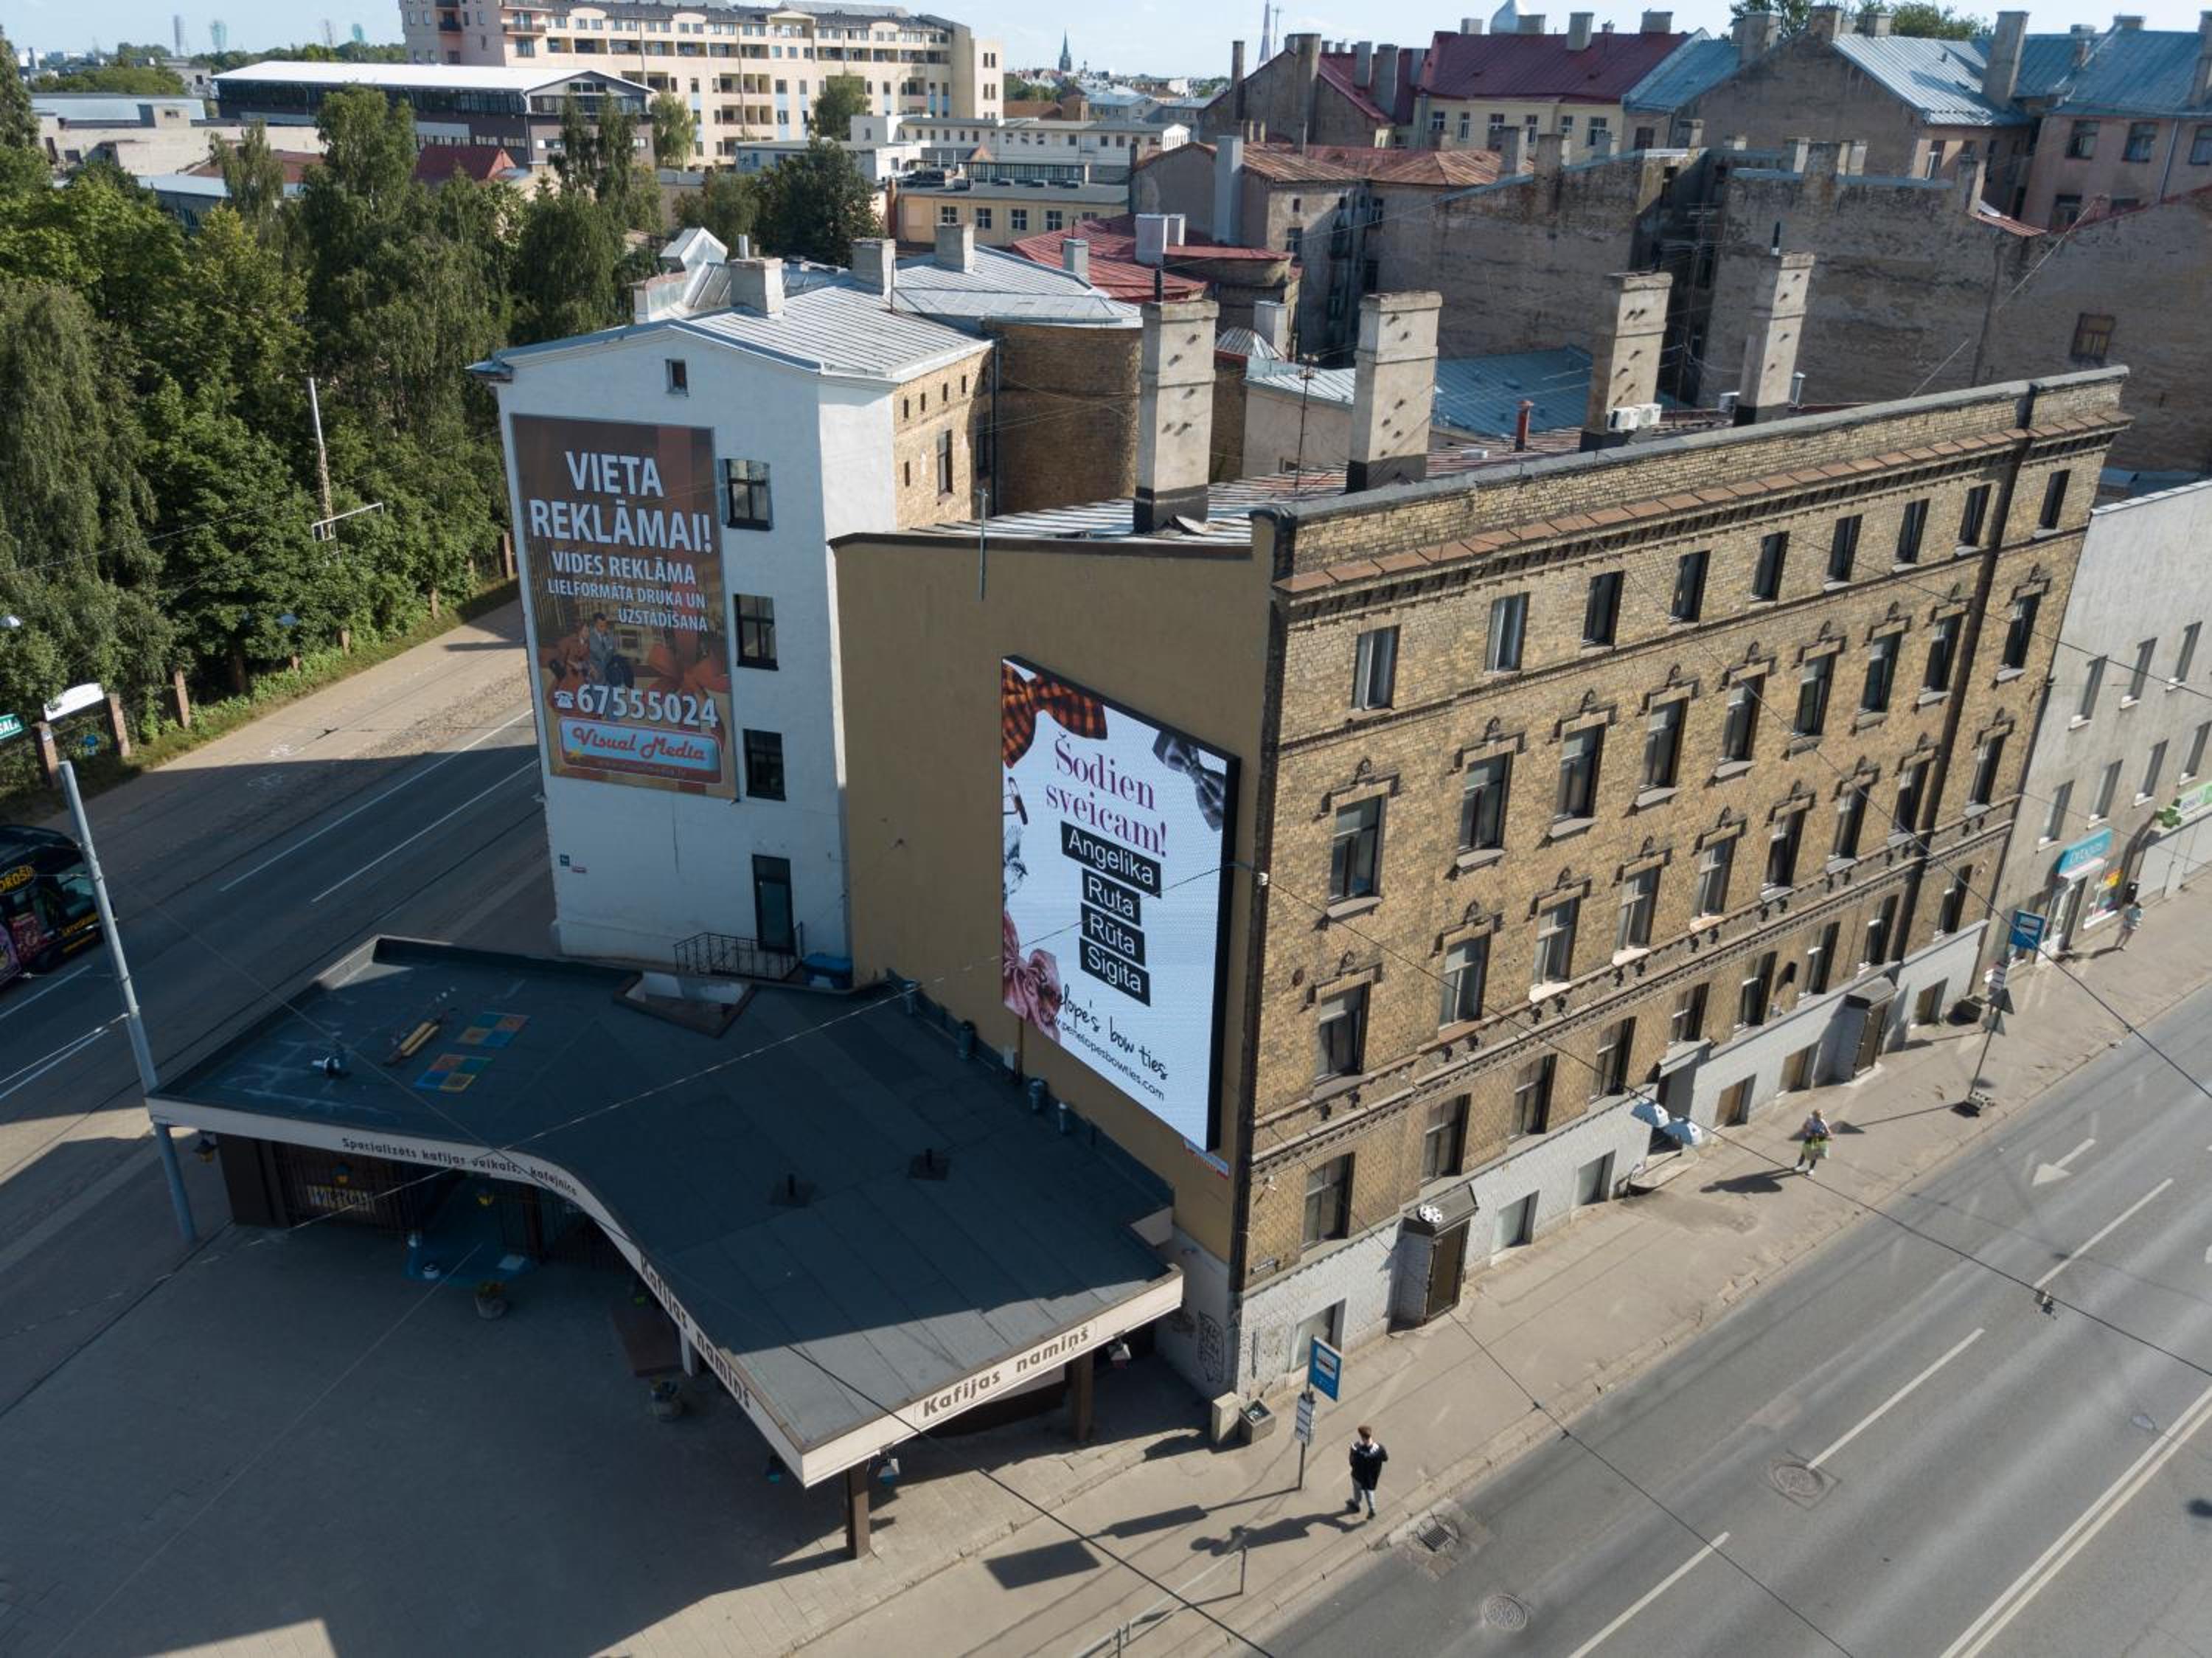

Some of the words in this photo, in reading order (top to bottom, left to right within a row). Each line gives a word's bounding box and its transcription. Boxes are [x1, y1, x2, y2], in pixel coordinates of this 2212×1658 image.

[566, 450, 664, 498] VIETA
[529, 499, 713, 554] REKLĀMAI!
[552, 551, 605, 576] VIDES
[608, 555, 697, 585] REKLĀMA
[636, 587, 683, 607] DRUKA
[686, 592, 706, 609] UN
[577, 684, 720, 728] 67555024
[572, 726, 637, 752] Visual
[640, 736, 708, 761] Media
[1054, 731, 1156, 812] Šodien
[1046, 784, 1167, 858] sveicam!
[1069, 829, 1155, 887] Angelika
[1088, 877, 1134, 918] Ruta
[1090, 915, 1135, 957] Rūta
[1087, 946, 1142, 993] Sigita
[1110, 1015, 1135, 1053] bow
[1138, 1044, 1169, 1081] ties
[641, 1257, 688, 1330] Kafijas
[923, 1370, 1001, 1417] Kafijas
[1016, 1325, 1089, 1373] namiņš
